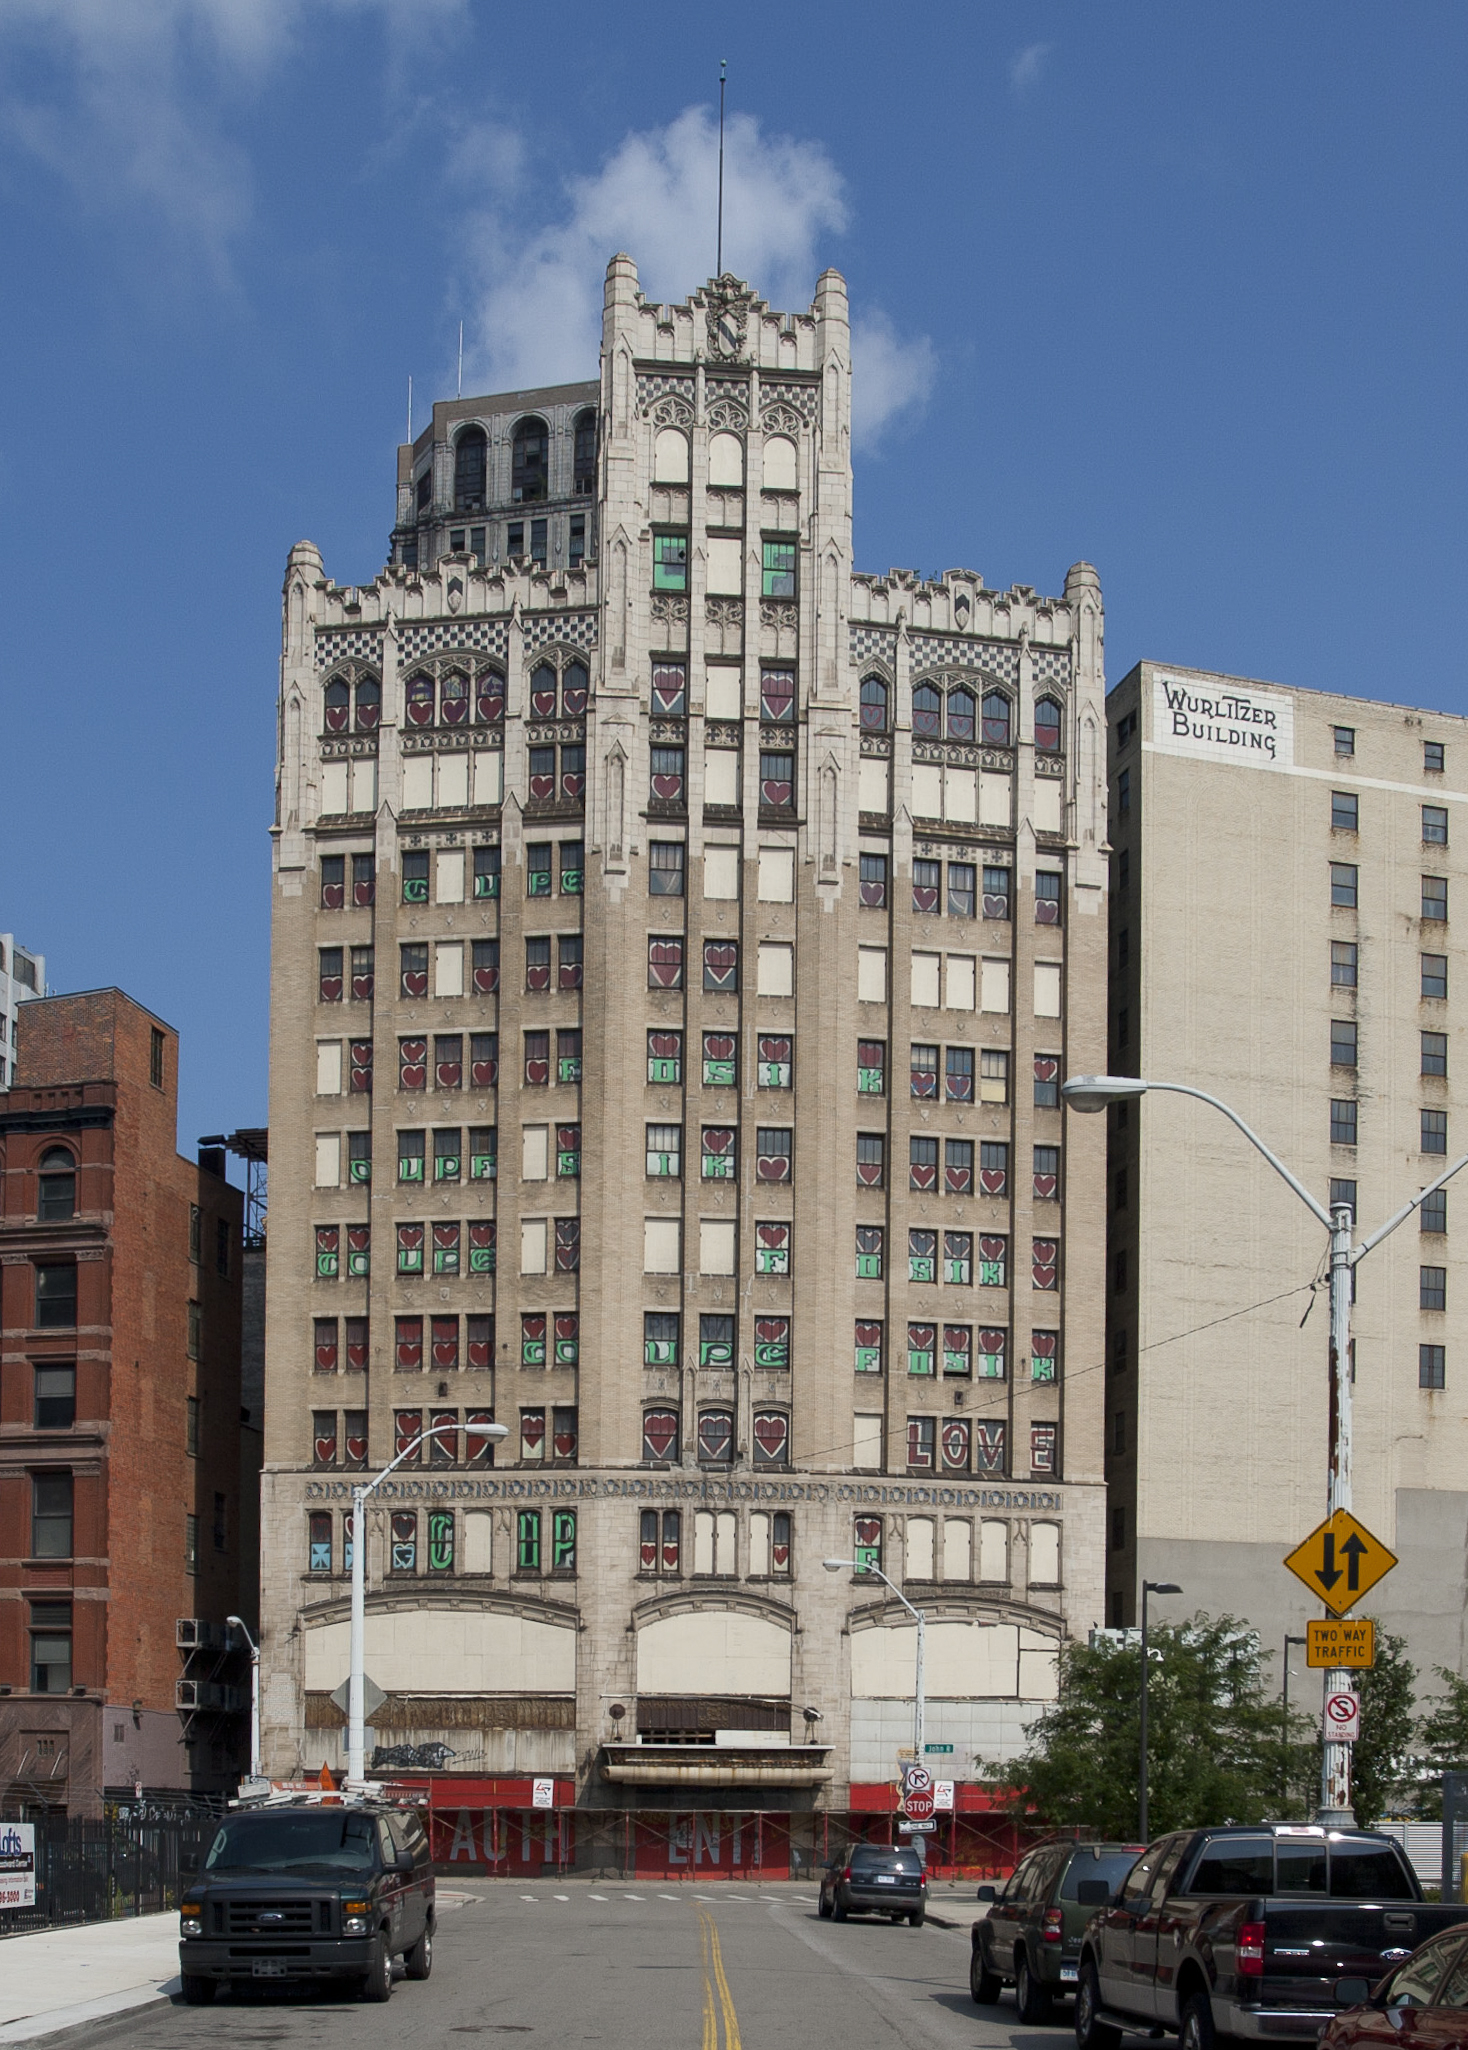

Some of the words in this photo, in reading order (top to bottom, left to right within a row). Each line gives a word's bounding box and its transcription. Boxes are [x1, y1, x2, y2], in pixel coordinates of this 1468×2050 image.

[1162, 680, 1277, 730] WURLITZER
[1172, 711, 1277, 760] BUILDING
[907, 1421, 1055, 1472] LOVE
[1314, 1630, 1338, 1642] TWO
[1343, 1629, 1367, 1642] WAY
[1314, 1645, 1365, 1658] TRAFFIC
[906, 1800, 933, 1812] STOP
[449, 1808, 569, 1861] AUTH
